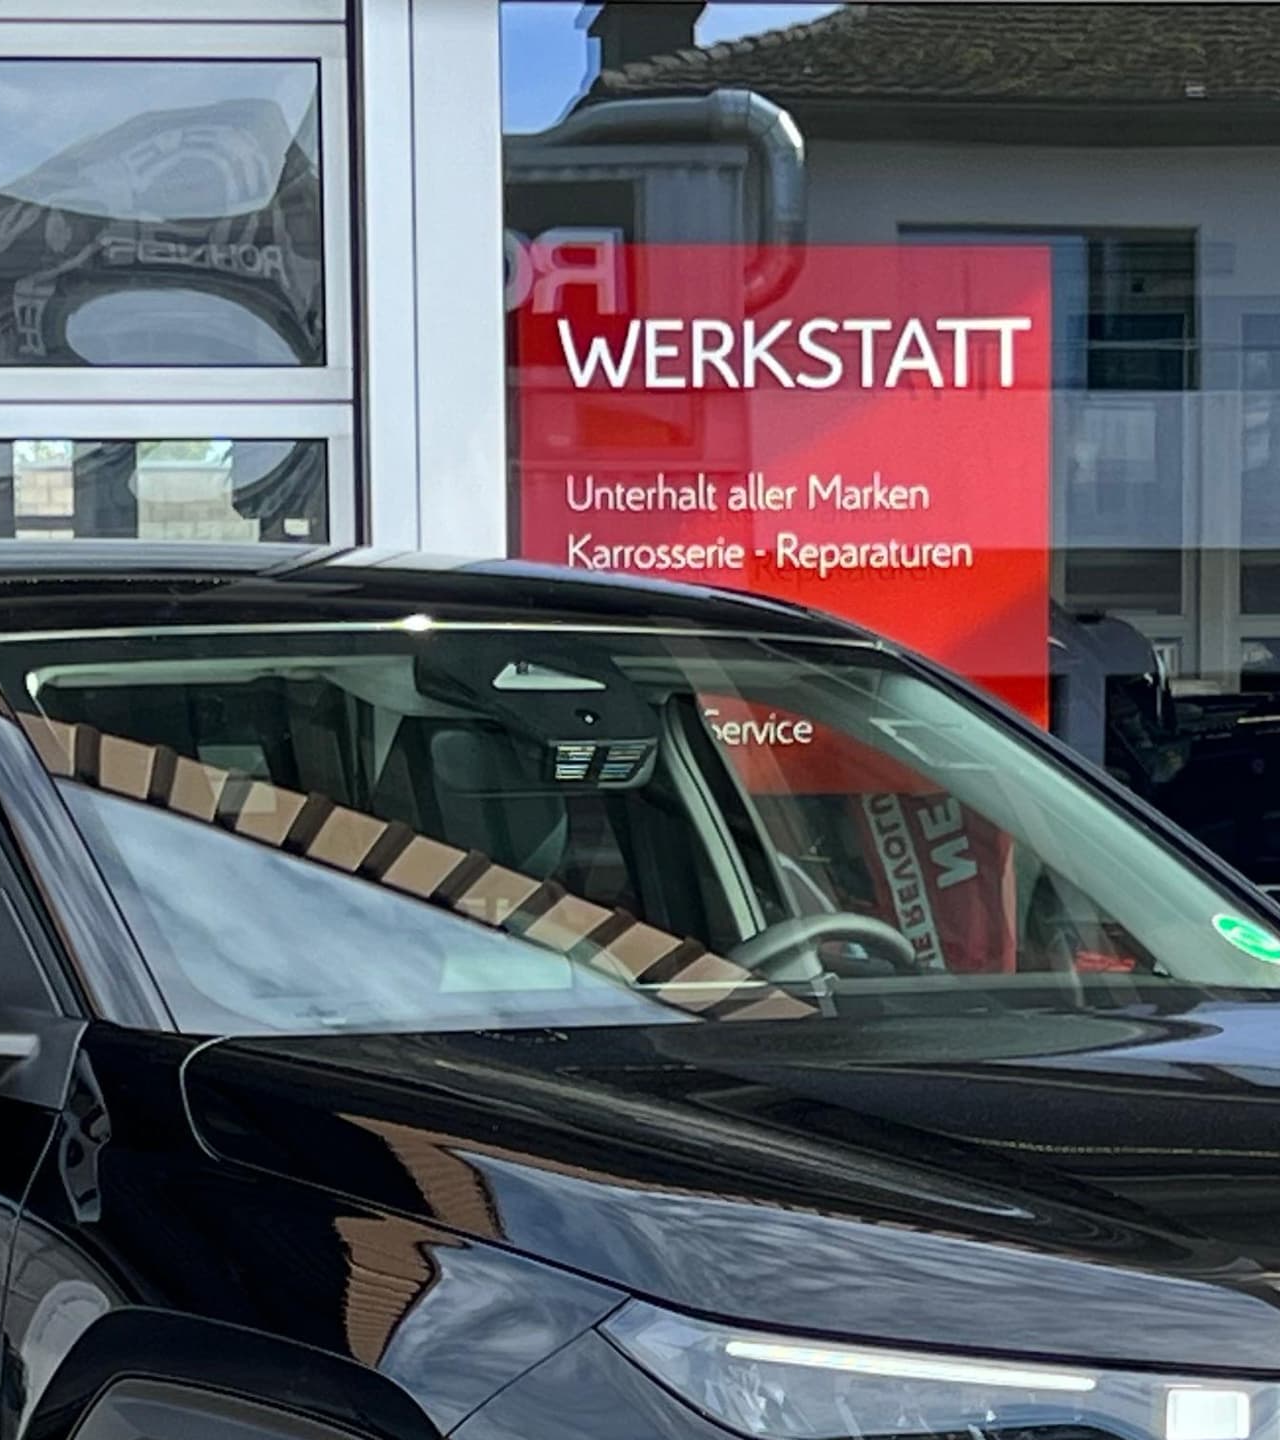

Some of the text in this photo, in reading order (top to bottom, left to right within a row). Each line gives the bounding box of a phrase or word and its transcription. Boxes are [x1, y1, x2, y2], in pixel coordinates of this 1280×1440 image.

[557, 317, 1032, 389] WERKSTATT
[565, 472, 930, 512] Unterhalt aller Marken
[567, 534, 744, 571] Karrosserie
[776, 531, 974, 578] Reparaturen
